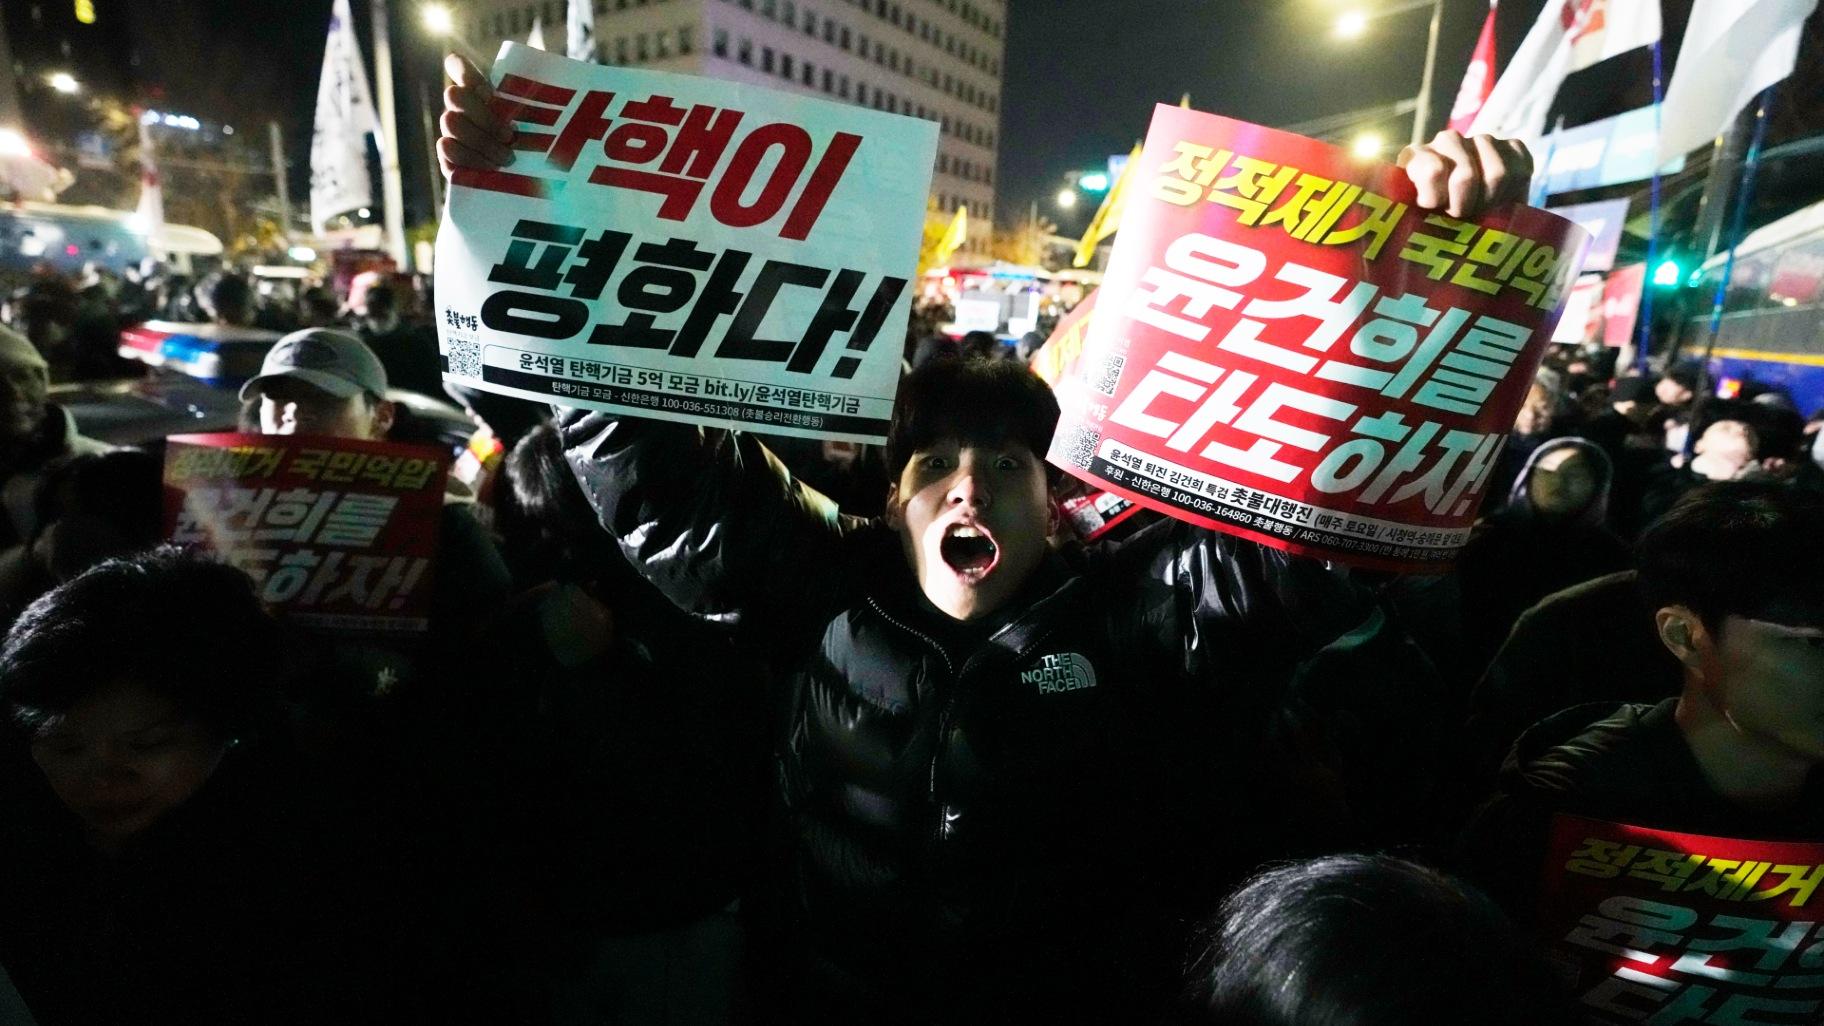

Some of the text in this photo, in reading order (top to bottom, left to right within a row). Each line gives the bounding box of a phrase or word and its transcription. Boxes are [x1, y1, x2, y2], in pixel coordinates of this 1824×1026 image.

[450, 73, 863, 241] 탄핵이
[1150, 140, 1409, 260] 정적제거
[480, 219, 908, 379] 평화다!
[1124, 232, 1534, 416] 윤건희를
[519, 353, 861, 414] 윤석열 탄핵기금 5억 모금 bit.ly/윤석열탄핵기금
[552, 381, 590, 397] 탄핵기금
[592, 388, 612, 400] 모금
[621, 392, 660, 407] 신한은행
[662, 397, 739, 417] 100-036-551308
[1108, 351, 1508, 517] 타도하자!
[1104, 465, 1125, 483] 후원
[1132, 475, 1171, 498] 신한은행
[1172, 491, 1252, 524] 100-036-164860
[1300, 531, 1321, 543] ARS
[1110, 448, 1142, 471] 윤석열
[1144, 462, 1168, 480] 퇴진
[1169, 470, 1204, 492] 김건희
[1205, 483, 1229, 500] 특검
[1230, 487, 1313, 524] 촛불대행진
[1343, 519, 1379, 538] 토요일
[1021, 664, 1073, 684] NORTH
[1038, 678, 1076, 695] FACE
[1041, 653, 1071, 667] THE
[1565, 837, 1824, 907] 정적제거
[1563, 895, 1824, 988] 윤건
